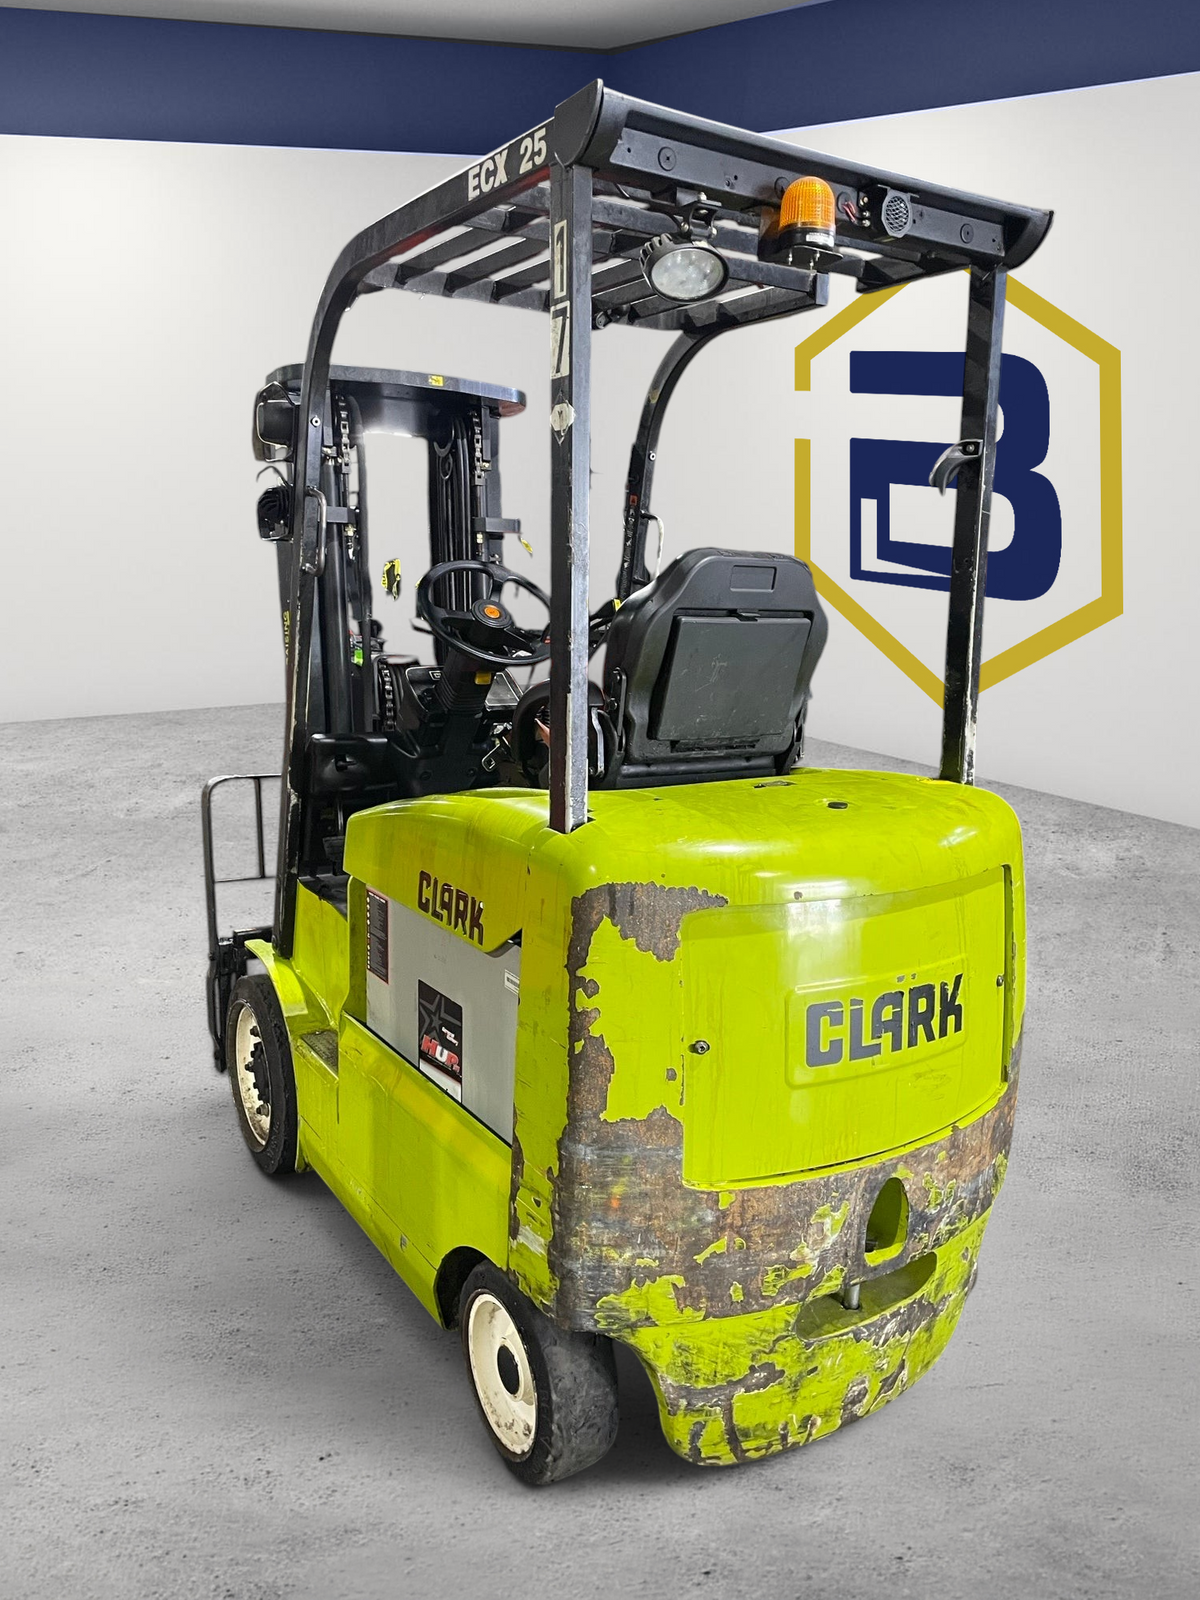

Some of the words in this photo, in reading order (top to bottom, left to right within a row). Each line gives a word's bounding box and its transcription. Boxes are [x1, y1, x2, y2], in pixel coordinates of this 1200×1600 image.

[467, 147, 508, 202] ECX
[519, 128, 547, 175] 25
[418, 870, 484, 946] CLARK
[805, 973, 964, 1068] CLARK
